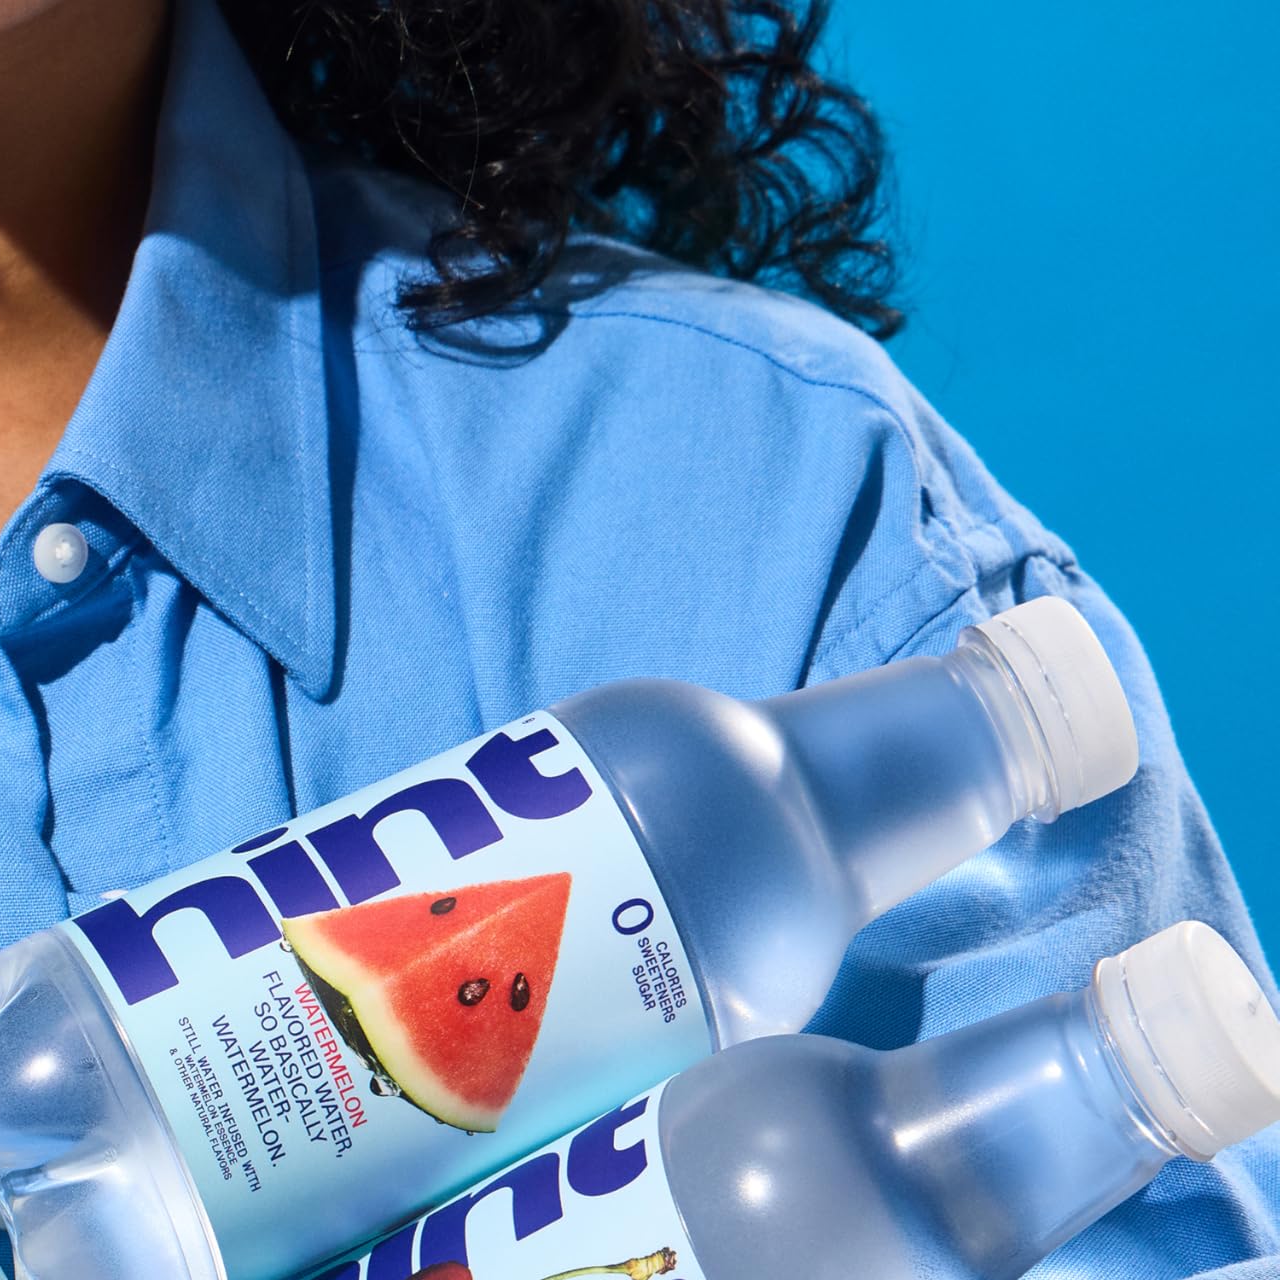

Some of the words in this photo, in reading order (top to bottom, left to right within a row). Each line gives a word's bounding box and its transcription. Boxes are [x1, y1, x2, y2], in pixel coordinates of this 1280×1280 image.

[78, 727, 593, 1006] hint
[612, 898, 654, 935] 0
[632, 965, 656, 1011] SUGAR
[638, 937, 676, 1023] SWEETENERS
[656, 941, 687, 1008] CALORIES
[178, 1016, 203, 1054] STILL
[197, 1055, 223, 1100] WATER
[218, 1102, 247, 1158] INFUSED
[242, 1160, 261, 1192] WITH
[184, 1054, 219, 1120] WATERMELON
[214, 1121, 238, 1165] ESSENCE
[212, 1014, 286, 1167] WATERMELON.
[249, 1040, 291, 1123] WATER-
[254, 1001, 278, 1032] SO
[269, 1035, 327, 1143] BASICALLY
[262, 970, 323, 1080] FLAVORED
[315, 1081, 353, 1158] WATER,
[294, 982, 368, 1128] WATERMELON
[174, 1058, 193, 1091] OTHER
[190, 1092, 212, 1137] NATURAL
[210, 1137, 232, 1181] FLAVORS
